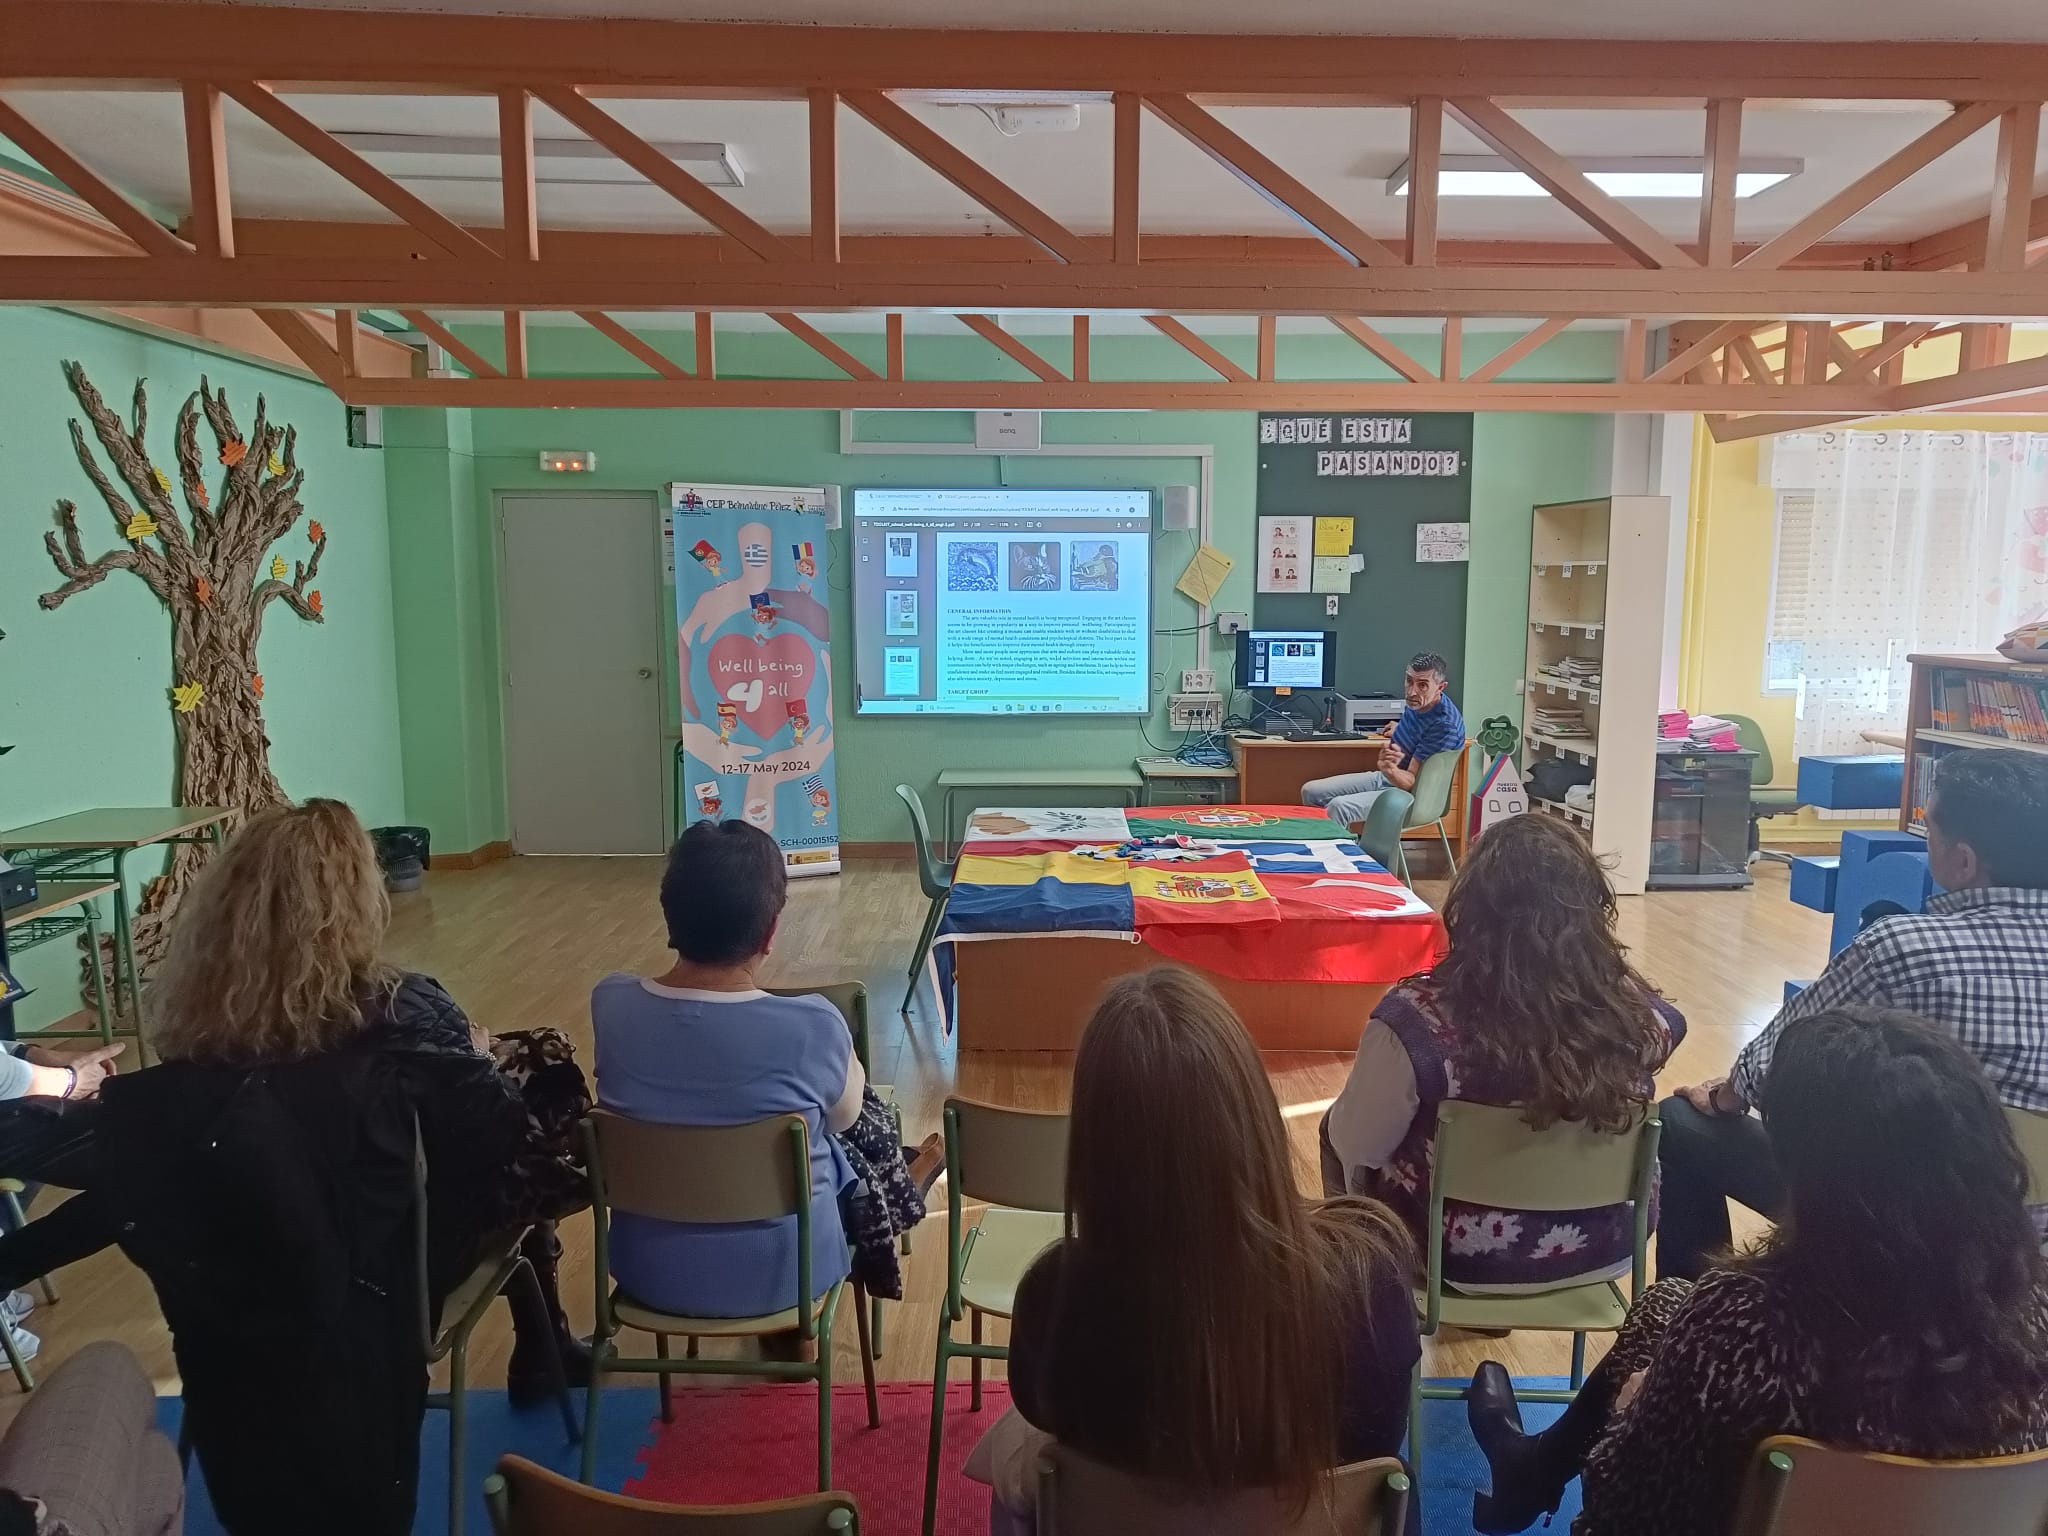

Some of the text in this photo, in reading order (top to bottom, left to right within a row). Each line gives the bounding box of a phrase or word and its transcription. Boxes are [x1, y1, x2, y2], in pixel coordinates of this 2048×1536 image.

[1345, 420, 1408, 438] ESTÁ
[1321, 456, 1455, 471] PASANDO?
[706, 500, 726, 509] CEIP
[727, 501, 767, 510] Bernardino
[719, 659, 804, 678] Well being
[727, 679, 788, 712] 4 all
[721, 761, 811, 774] 12-17 May 2024
